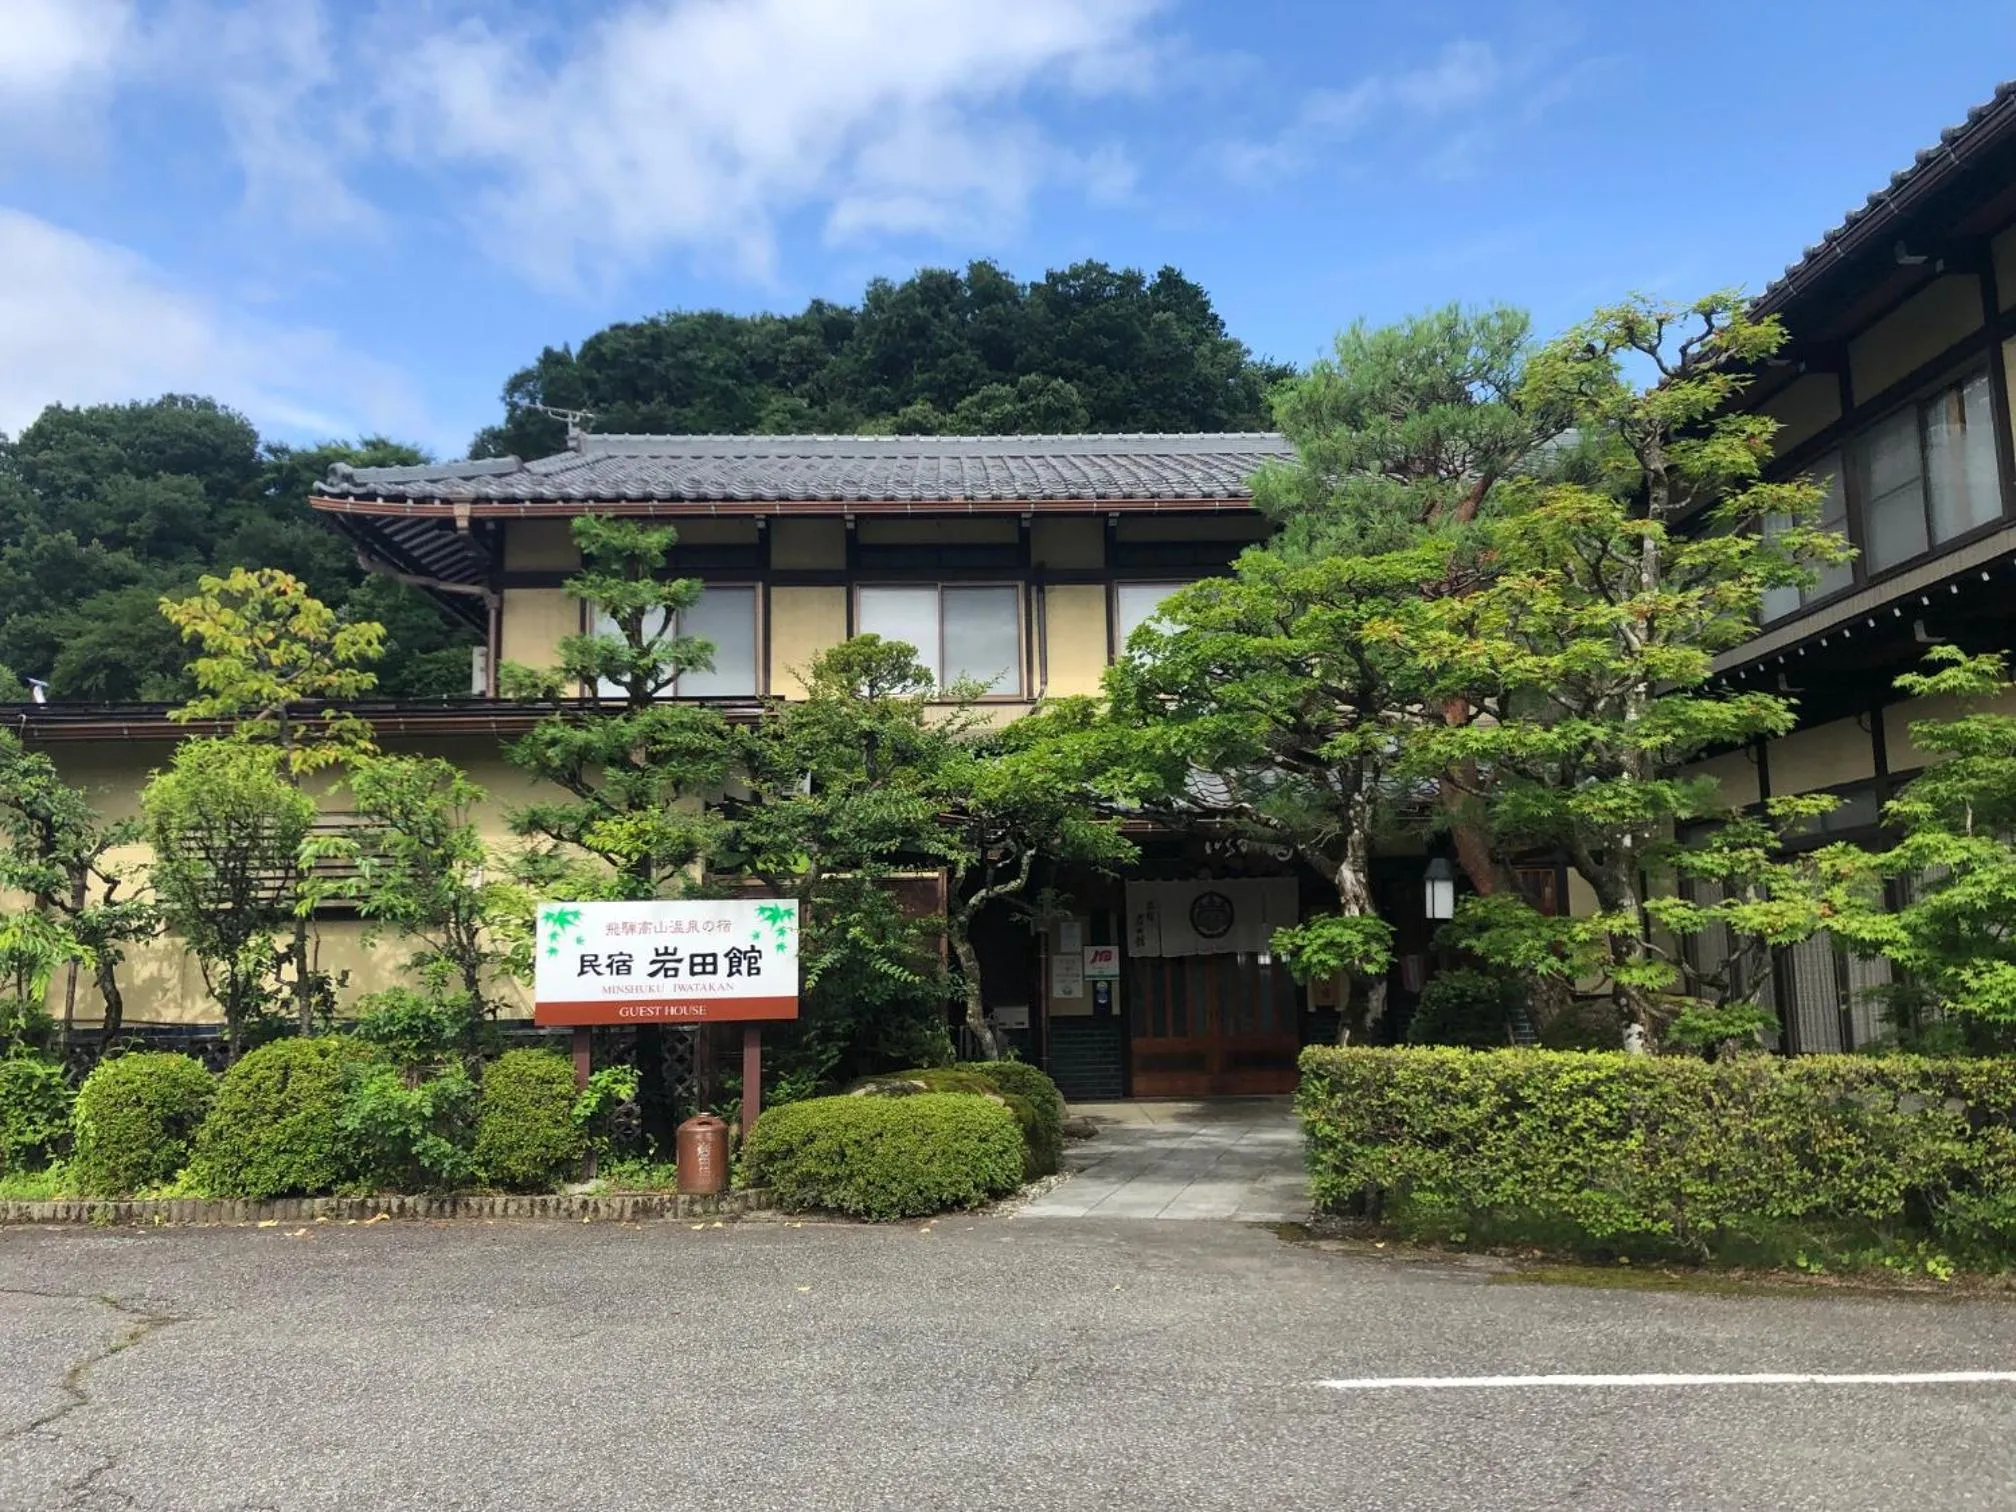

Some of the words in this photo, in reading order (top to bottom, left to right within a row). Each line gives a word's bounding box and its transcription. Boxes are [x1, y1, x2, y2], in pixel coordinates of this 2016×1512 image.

[577, 951, 634, 977] 民宿
[647, 945, 763, 978] 岩田館
[1089, 950, 1113, 964] JTB
[602, 984, 664, 995] MINSHUKU
[673, 982, 735, 993] IWATAKAN
[619, 1006, 662, 1017] GUEST
[664, 1005, 707, 1016] HOUSE
